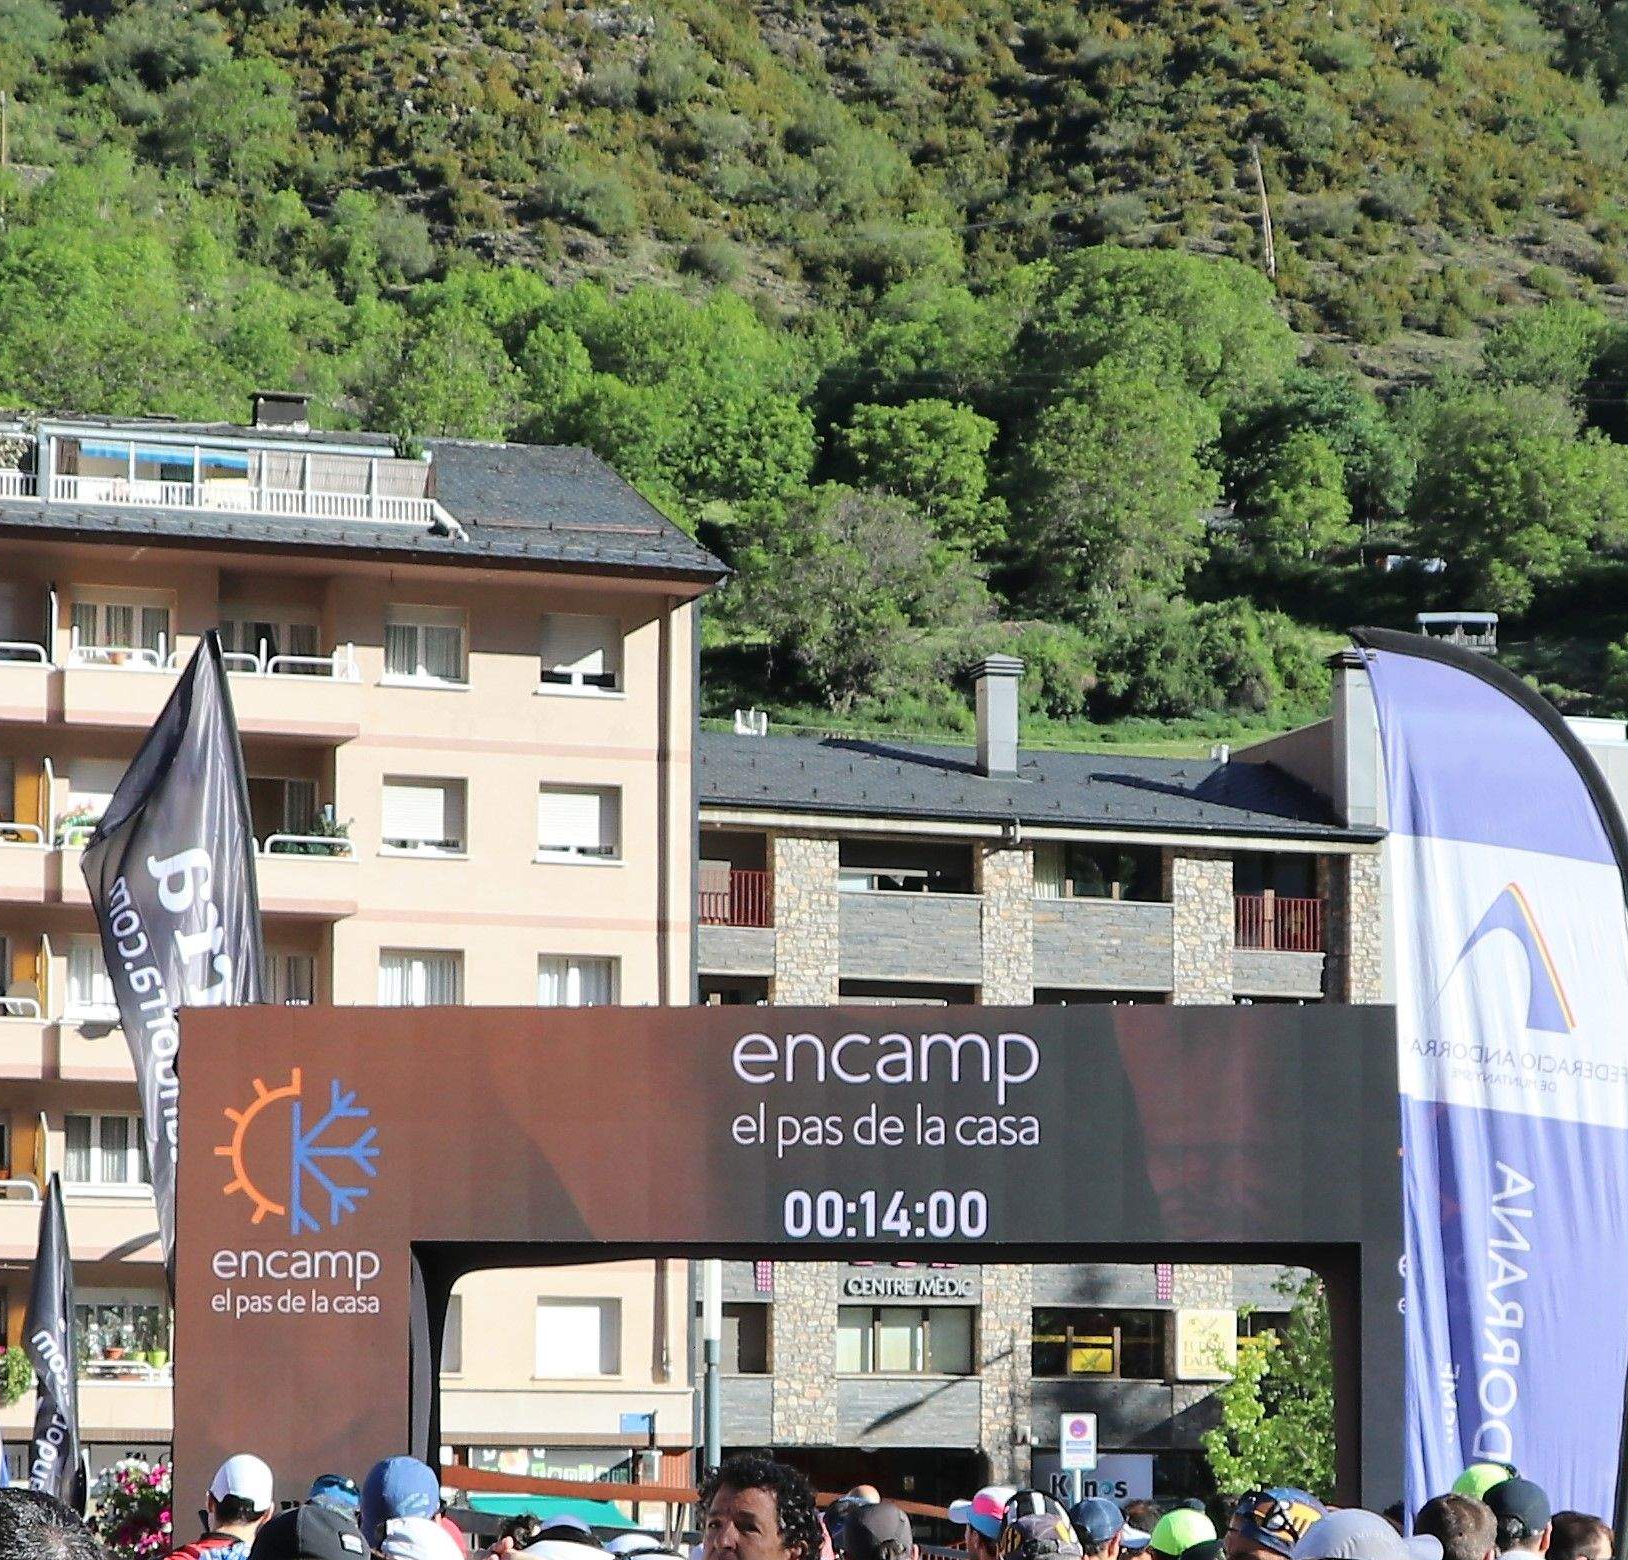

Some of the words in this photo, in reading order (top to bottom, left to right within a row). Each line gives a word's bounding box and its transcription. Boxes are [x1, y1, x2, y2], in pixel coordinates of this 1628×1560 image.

[732, 1031, 1040, 1105] encamp
[731, 1102, 765, 1145] el
[777, 1115, 844, 1158] pas
[853, 1102, 905, 1145] de
[916, 1102, 946, 1146] la
[954, 1115, 1040, 1146] casa
[784, 1190, 987, 1238] 00:14:00
[212, 1249, 381, 1291] encamp
[845, 1276, 915, 1296] CENTRE
[211, 1287, 231, 1312] el
[235, 1294, 273, 1320] pas
[277, 1288, 306, 1313] de
[311, 1288, 329, 1313] la
[332, 1295, 380, 1314] casa
[1050, 1473, 1129, 1499] Knos
